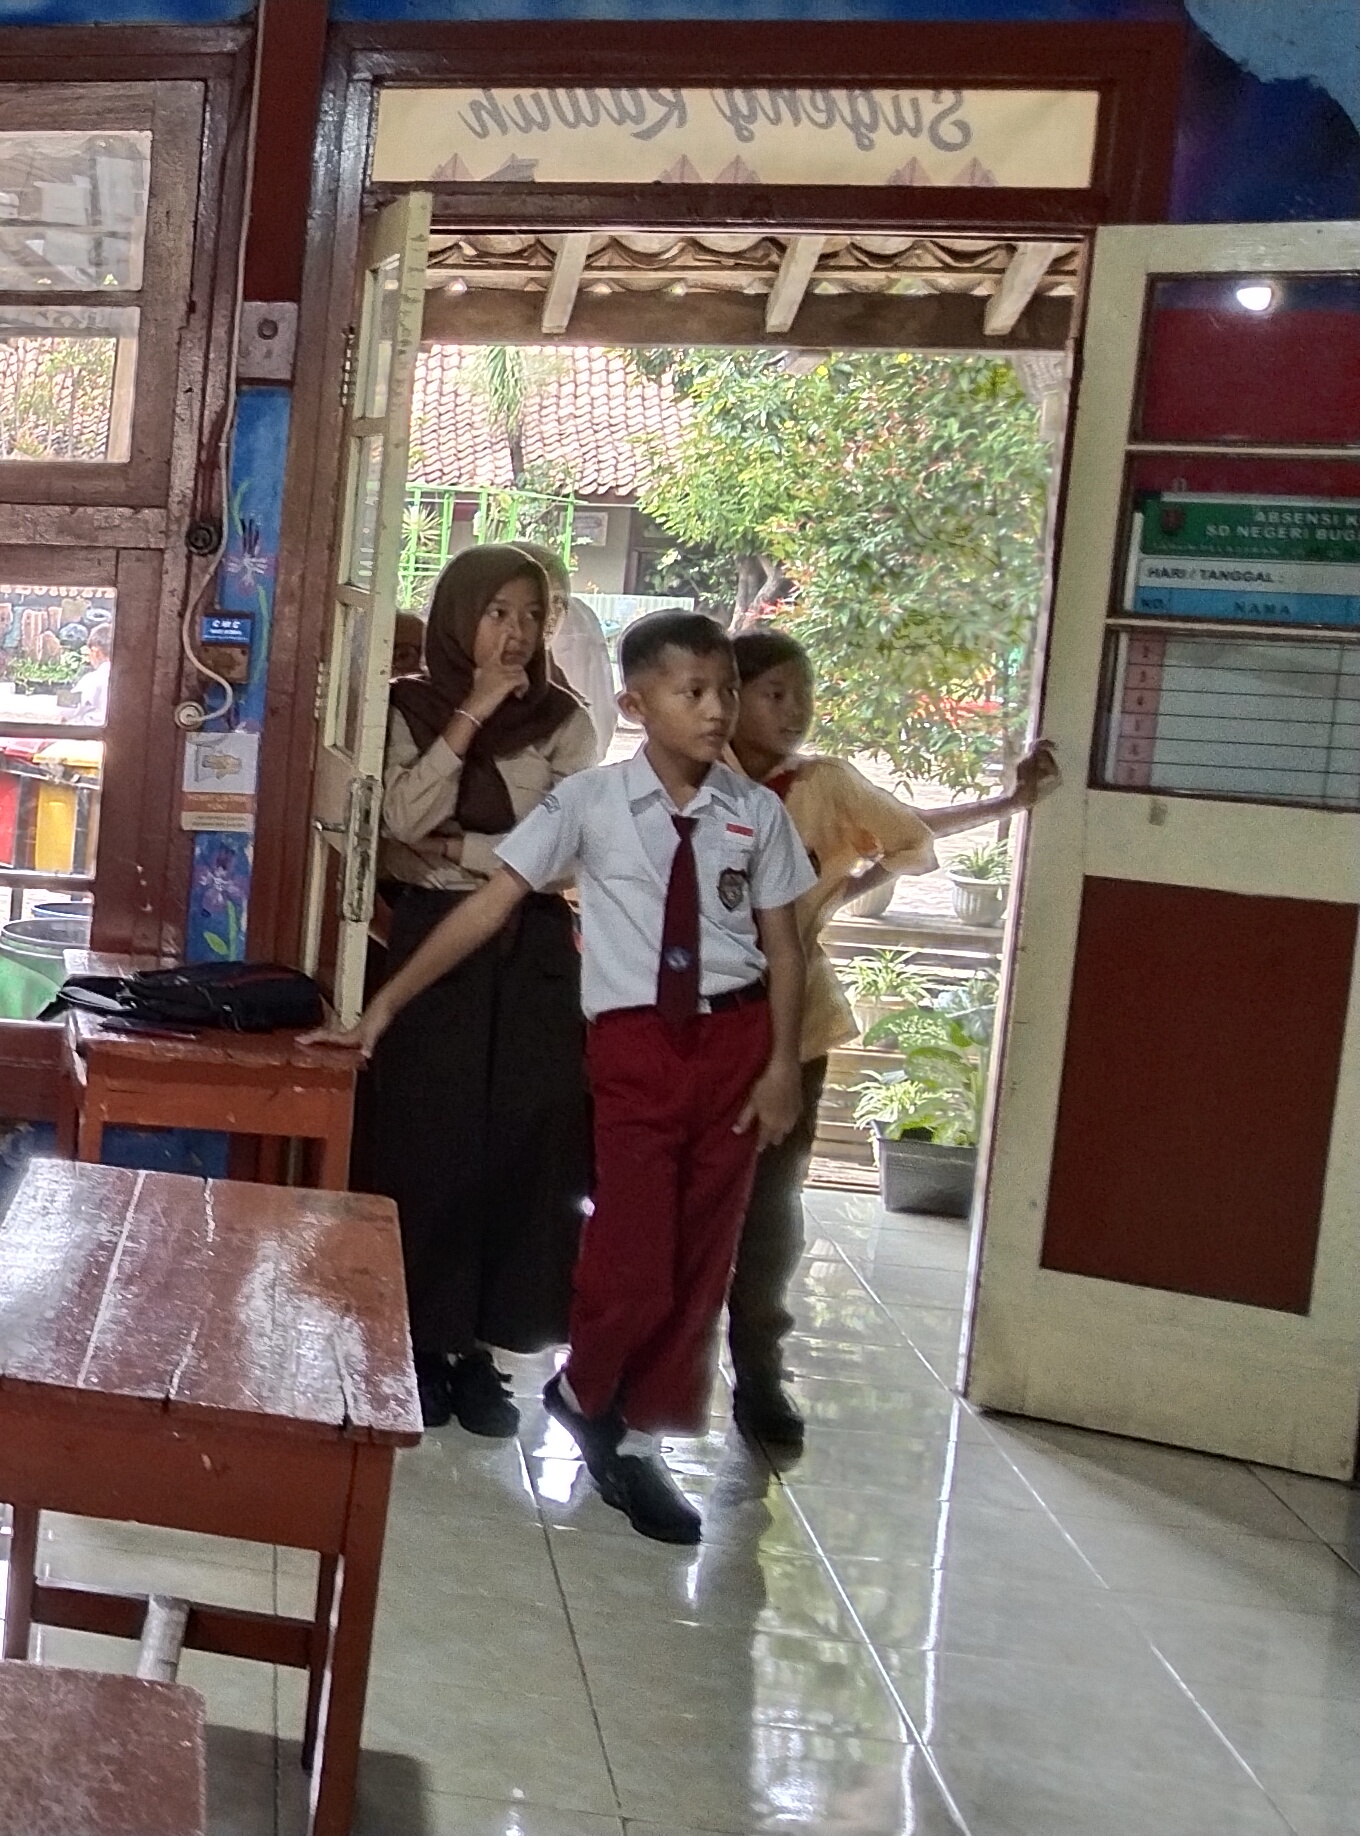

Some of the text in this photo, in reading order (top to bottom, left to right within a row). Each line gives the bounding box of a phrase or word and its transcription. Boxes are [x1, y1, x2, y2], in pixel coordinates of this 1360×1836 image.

[1254, 510, 1360, 528] ABSENSI K
[1236, 525, 1310, 540] NEGERI
